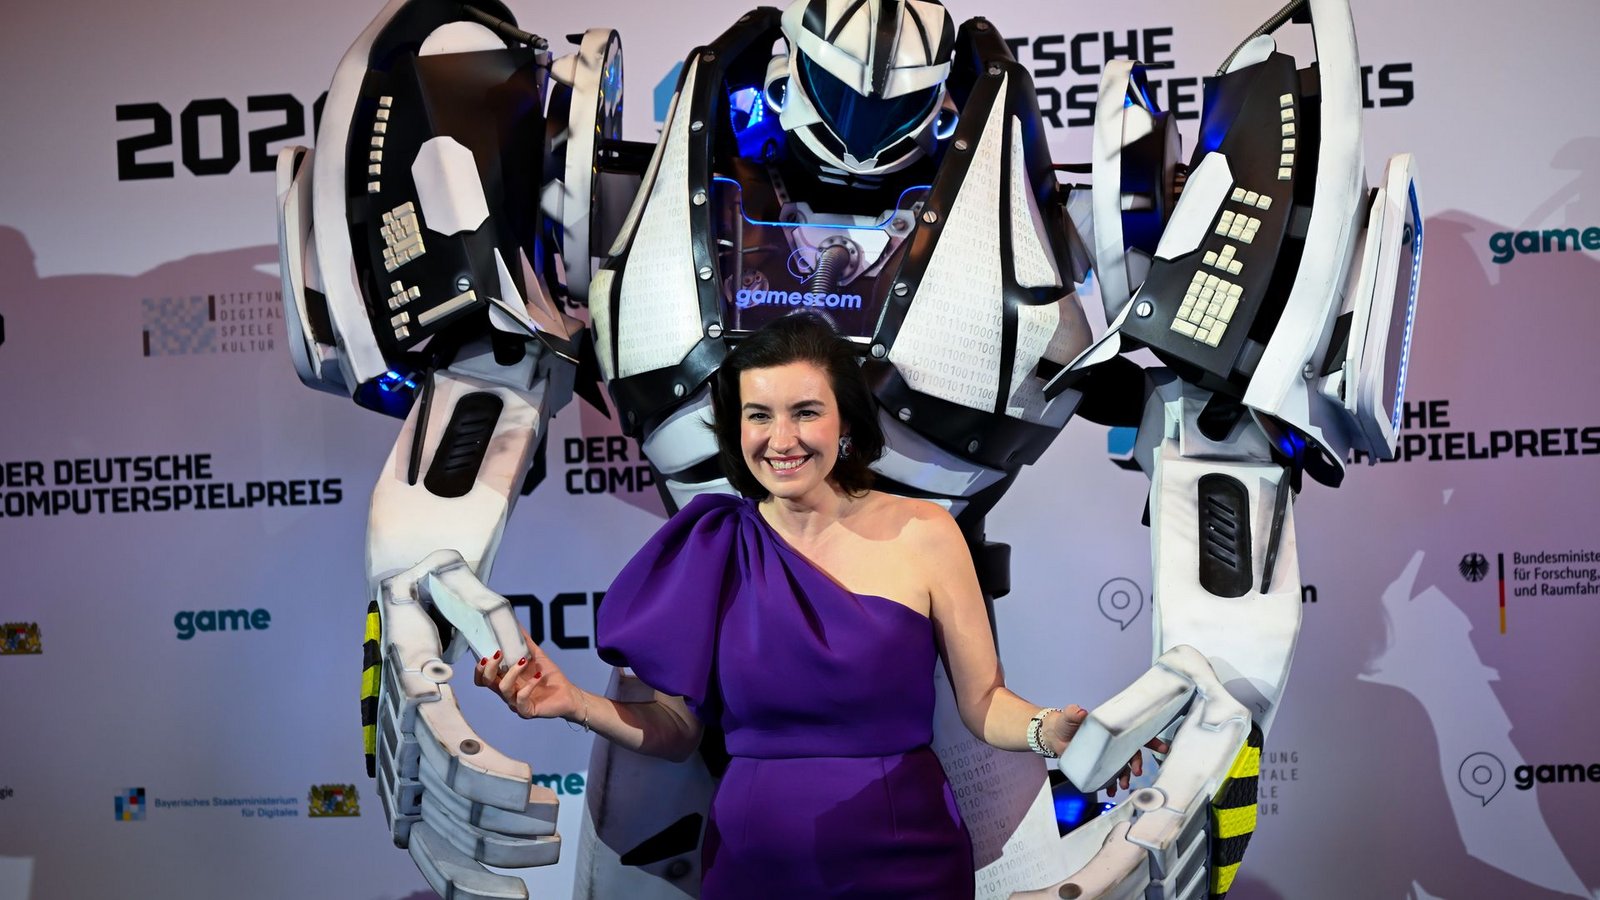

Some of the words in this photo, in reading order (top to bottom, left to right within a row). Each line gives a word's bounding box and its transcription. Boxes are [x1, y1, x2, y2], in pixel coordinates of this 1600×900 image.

[115, 89, 329, 181] 202
[1488, 226, 1600, 265] game
[735, 288, 862, 310] gamescom
[221, 323, 274, 337] SPIELE
[221, 339, 275, 353] KULTUR
[563, 435, 629, 464] DER
[0, 460, 45, 488] ER
[54, 453, 213, 486] DEUTSCHE
[0, 478, 342, 517] OMPUTERSPIELPREIS
[1513, 567, 1531, 581] für
[1514, 583, 1538, 597] und
[174, 607, 271, 641] game
[1514, 763, 1600, 791] game
[154, 797, 211, 809] Bayerisches
[212, 795, 299, 808] Staatsministerium
[241, 807, 255, 819] für
[257, 806, 299, 819] Digitales
